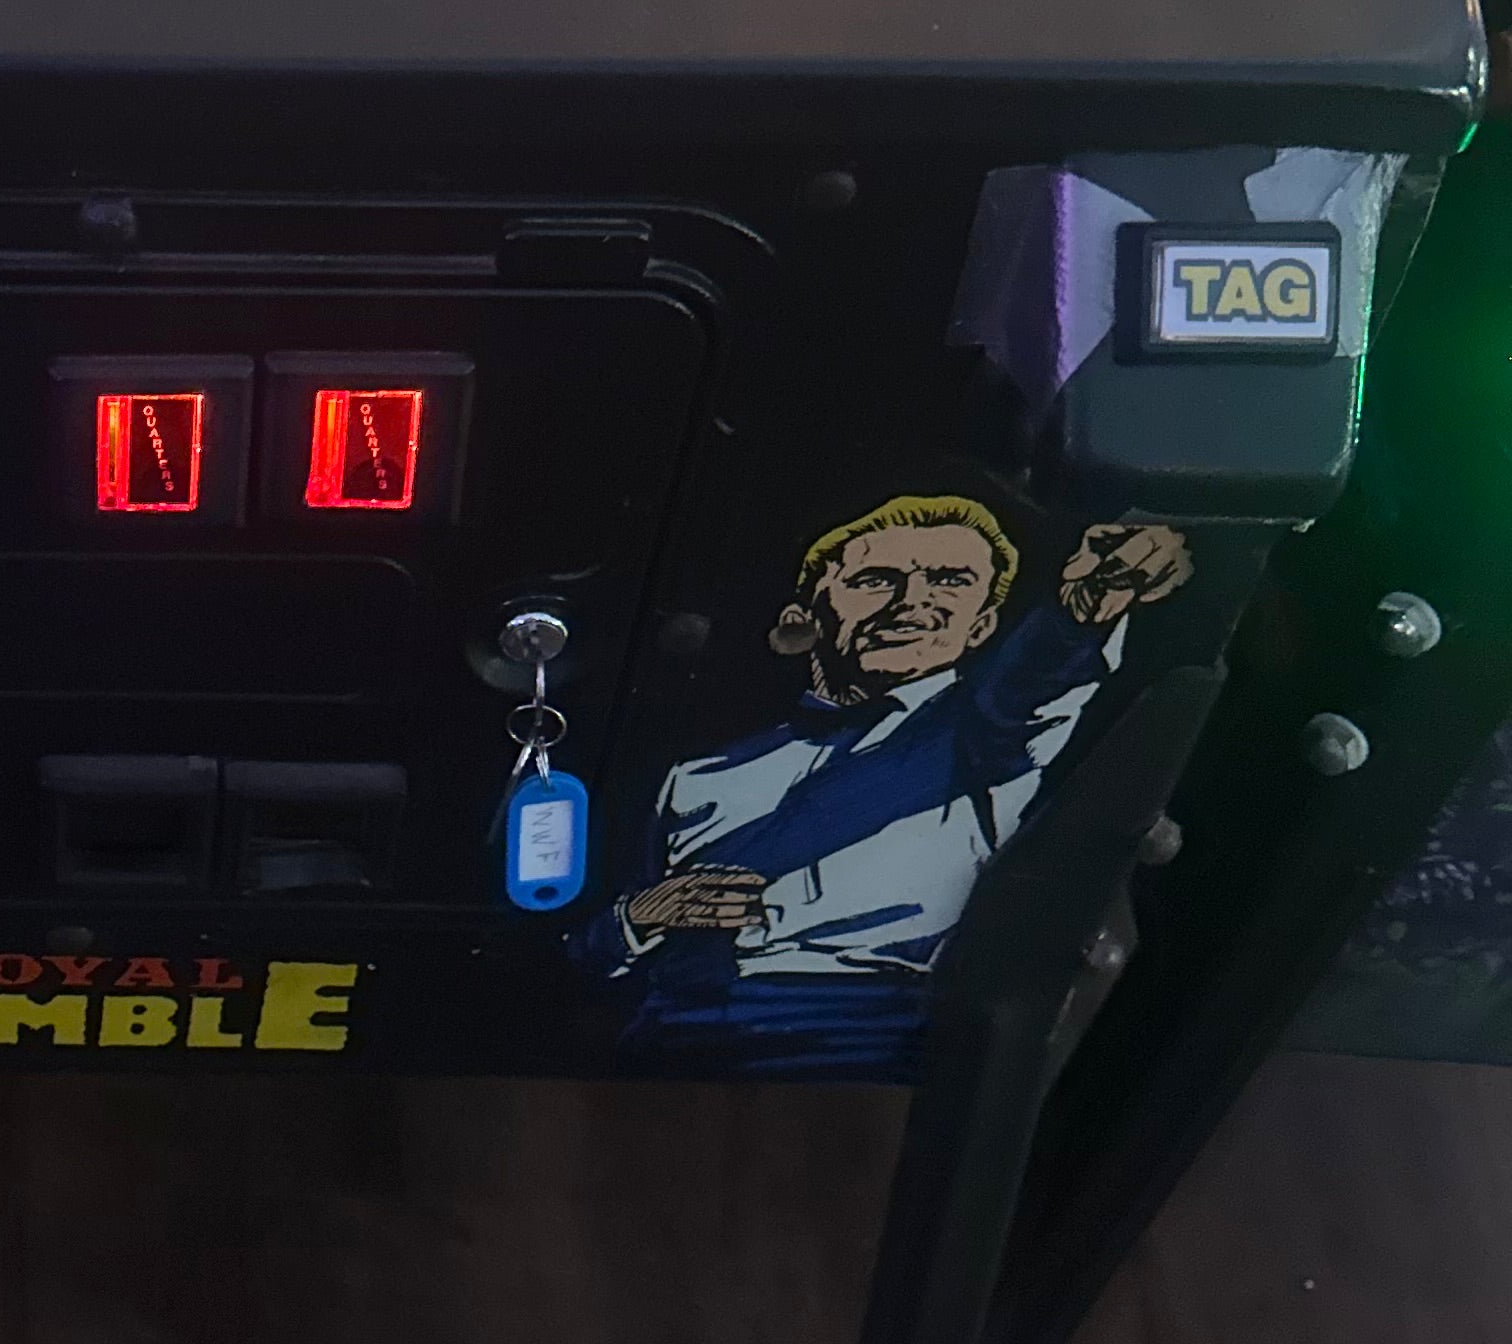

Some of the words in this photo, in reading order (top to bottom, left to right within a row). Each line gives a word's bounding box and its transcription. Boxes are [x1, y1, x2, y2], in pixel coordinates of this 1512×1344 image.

[1174, 259, 1316, 323] TAG
[142, 404, 176, 493] QUARTERS
[359, 402, 389, 491] QUARTERS
